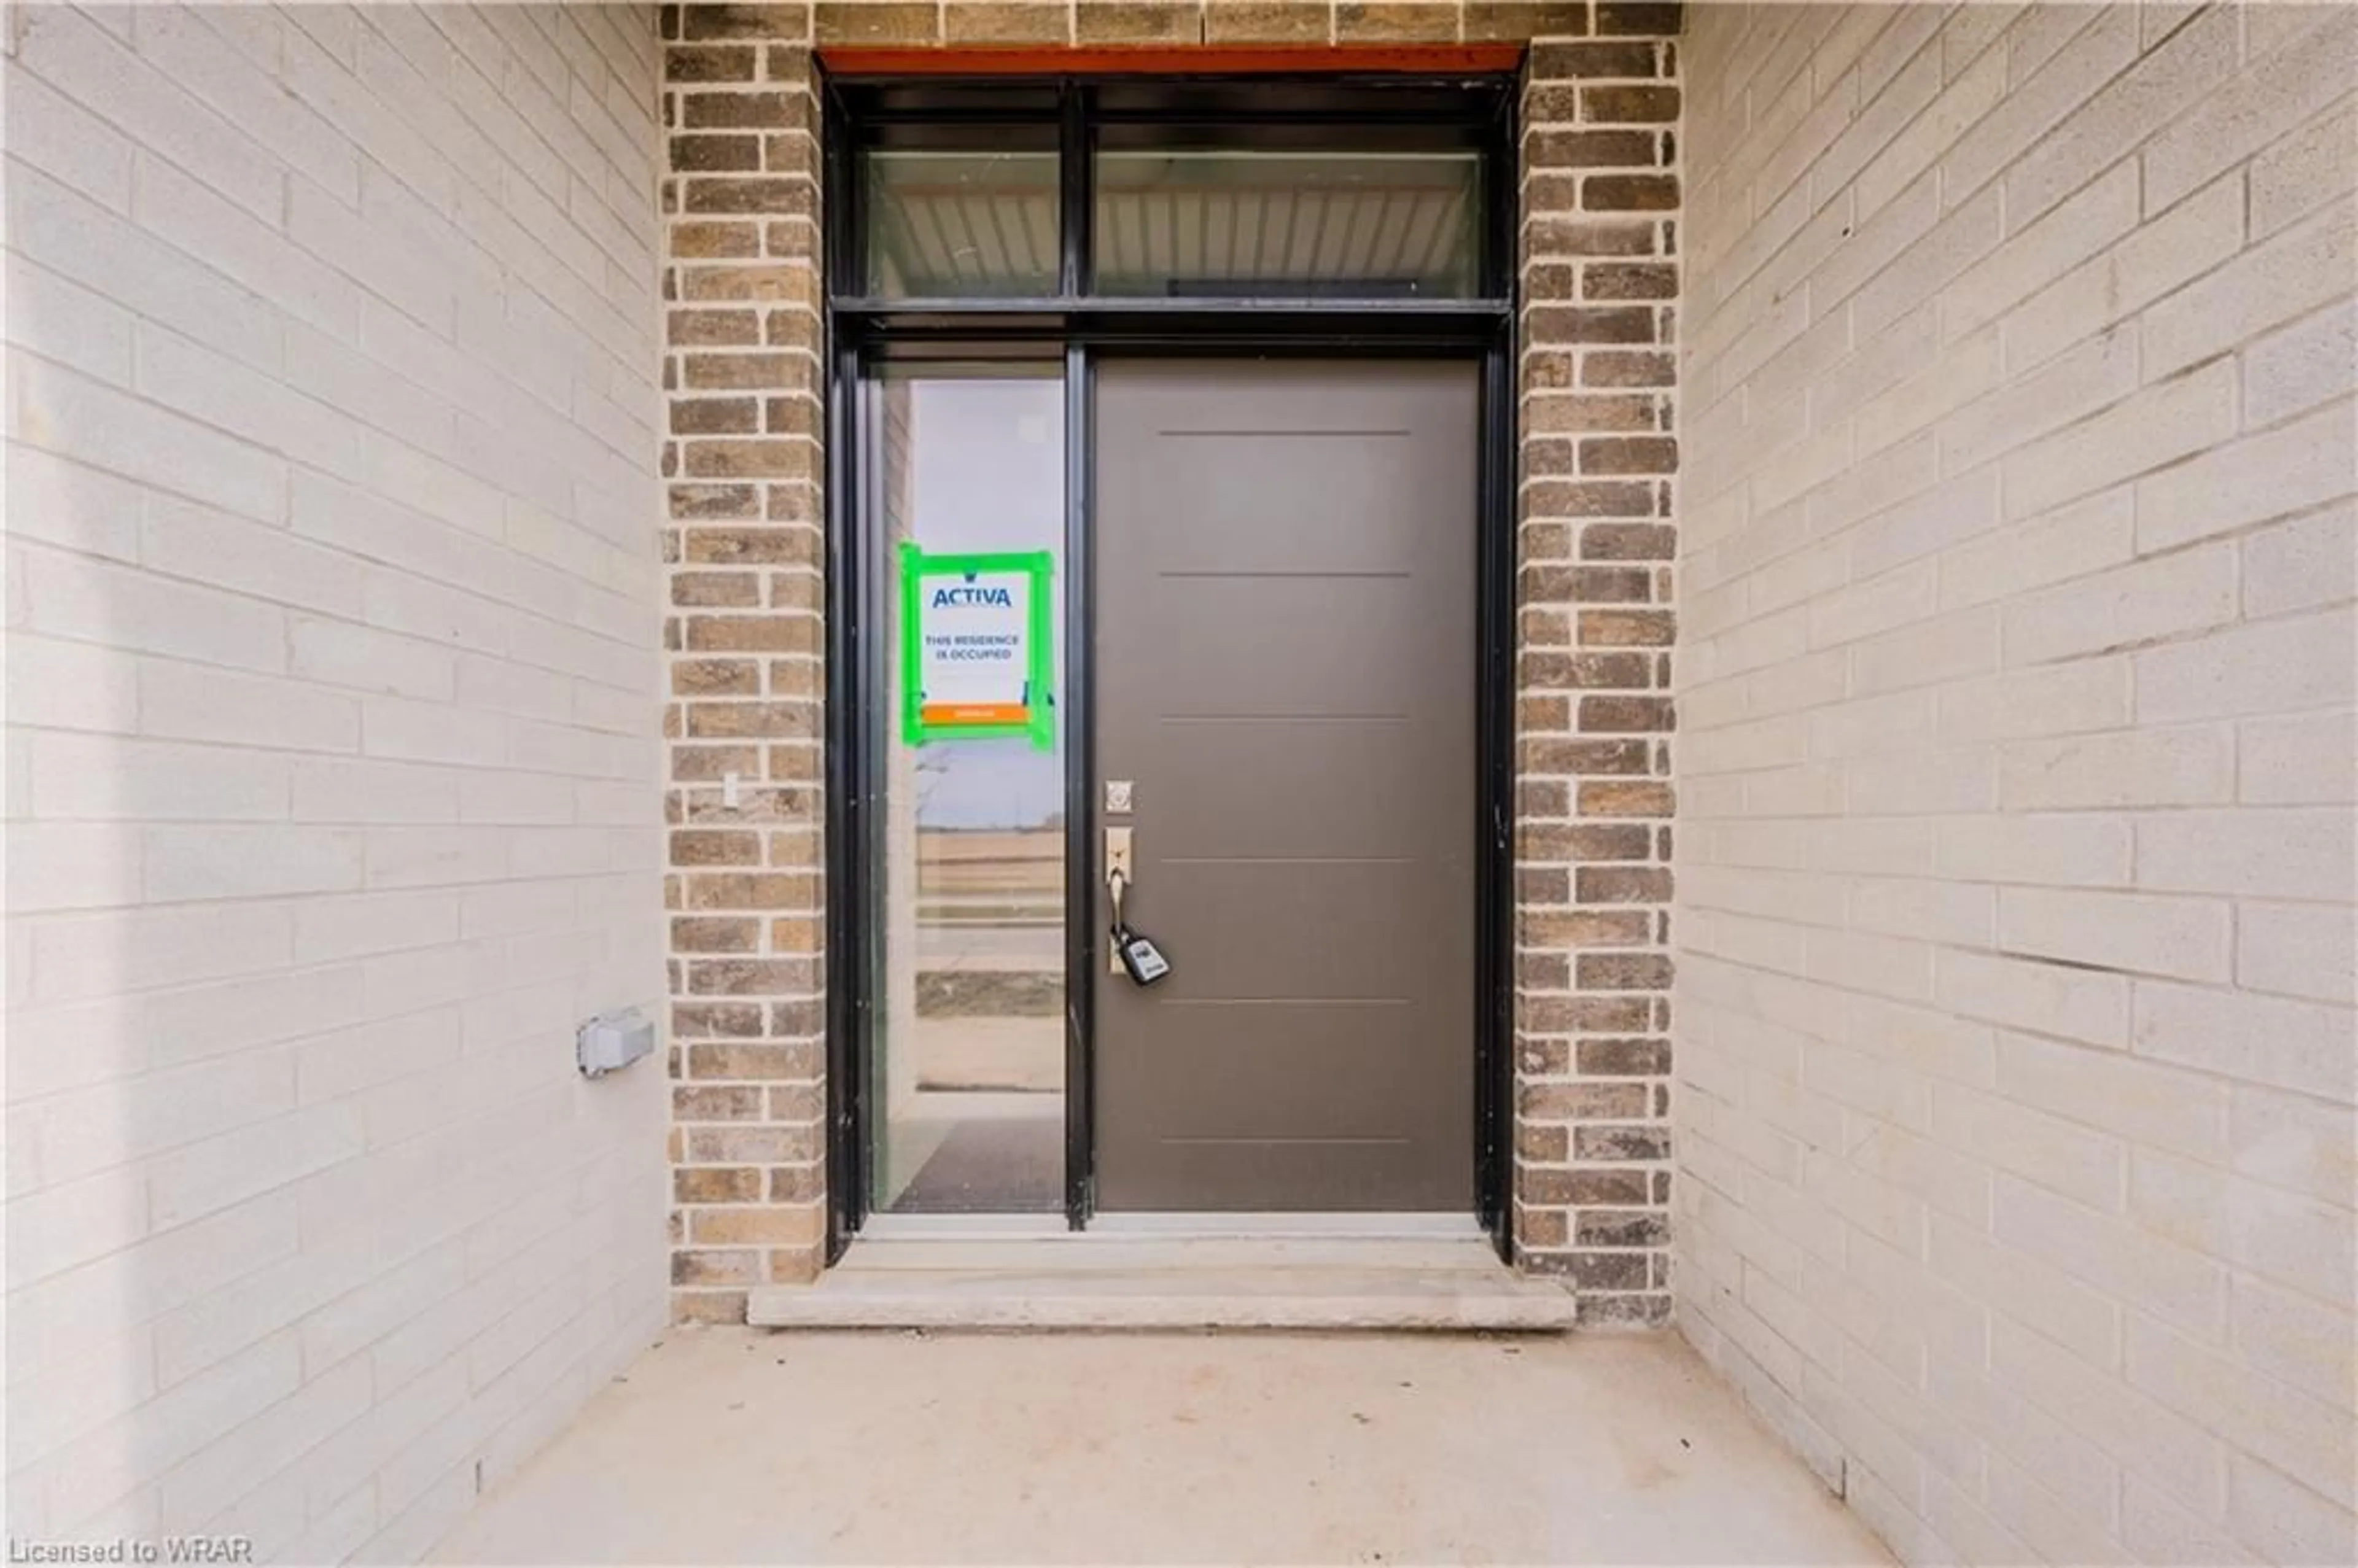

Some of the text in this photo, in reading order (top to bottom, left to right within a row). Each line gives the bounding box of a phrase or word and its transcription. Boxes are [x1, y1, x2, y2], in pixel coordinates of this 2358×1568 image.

[932, 588, 1012, 608] ACTIVA
[925, 635, 1019, 645] THIS RESIDENCE
[950, 648, 1012, 661] OCCUPIED
